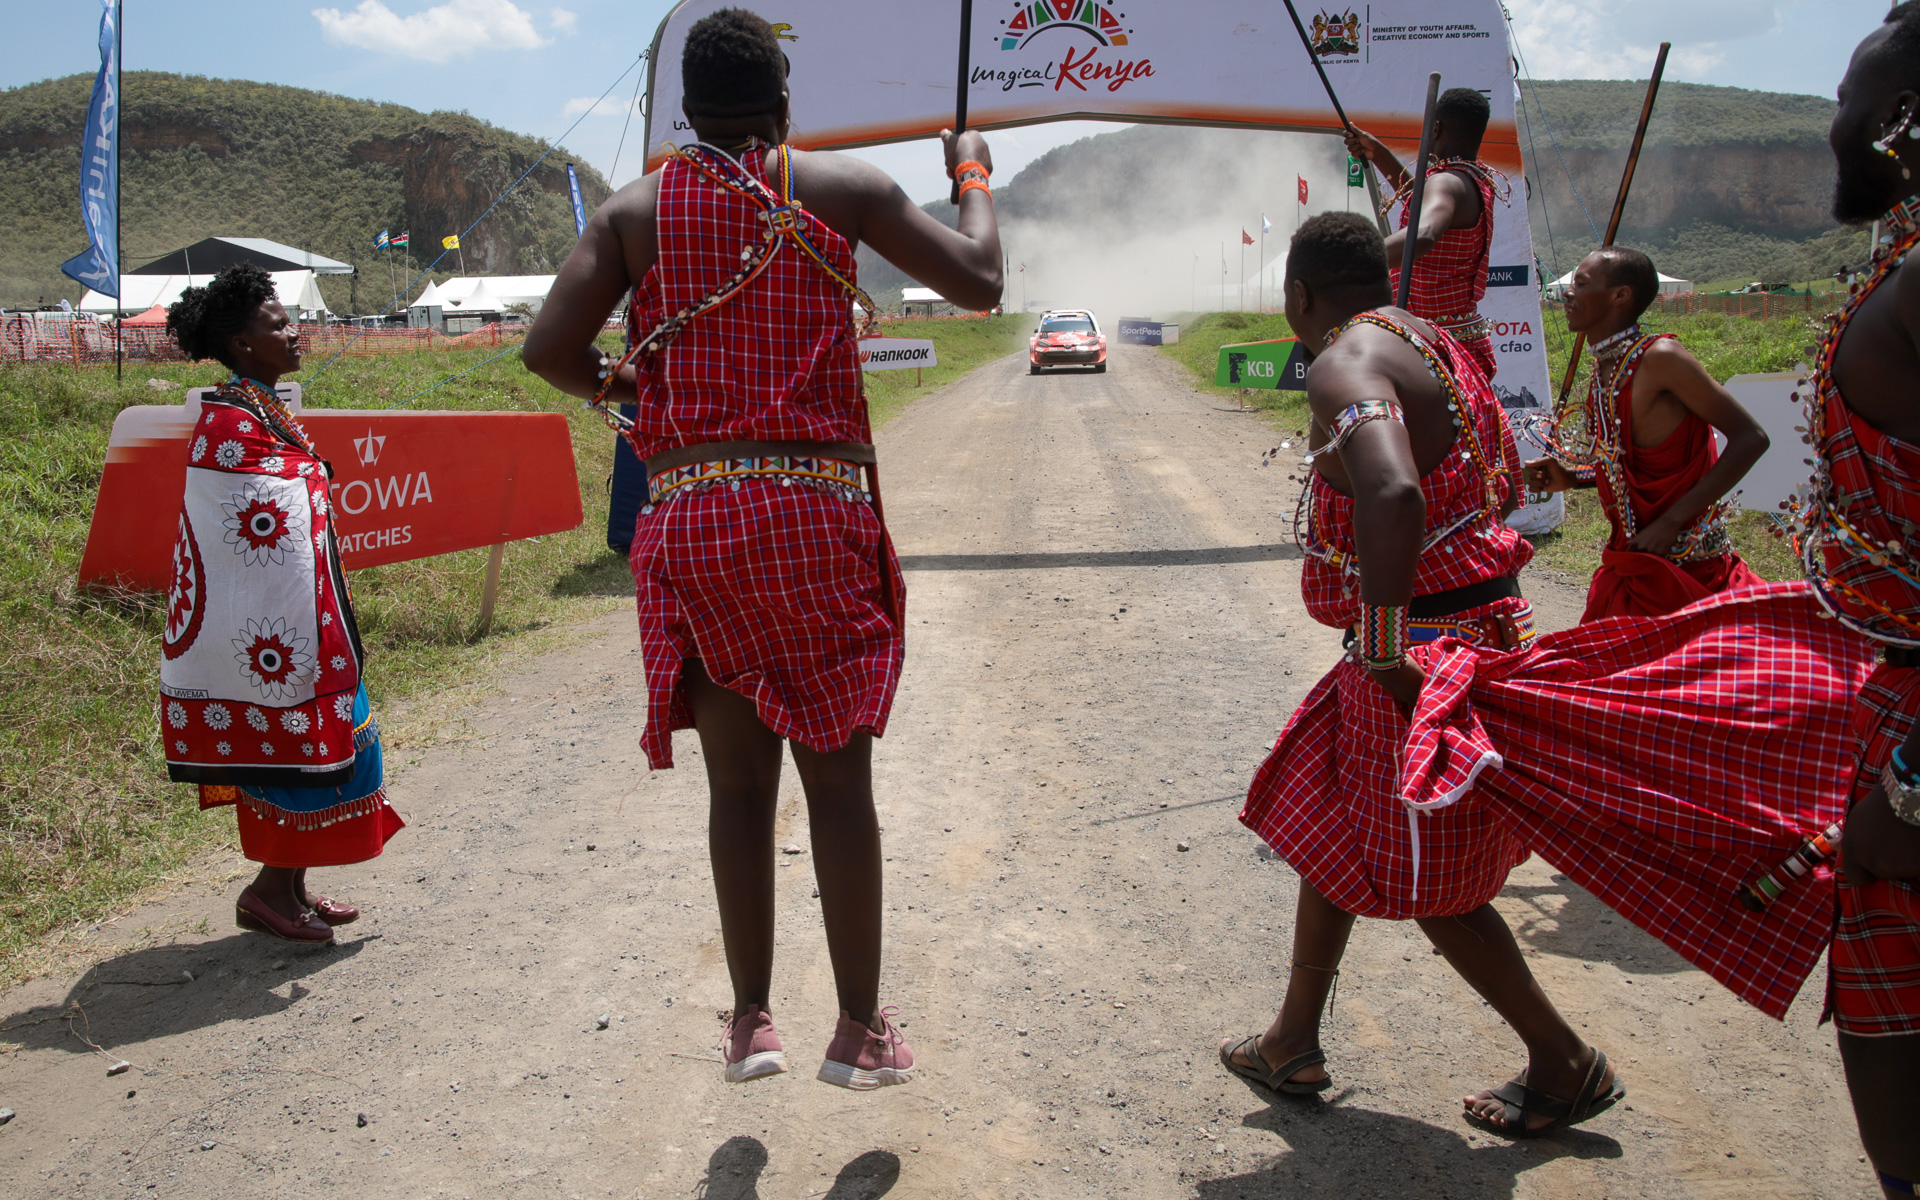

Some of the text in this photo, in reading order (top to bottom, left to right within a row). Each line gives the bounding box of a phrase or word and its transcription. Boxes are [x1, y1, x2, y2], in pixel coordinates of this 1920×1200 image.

[1054, 46, 1157, 92] Kenya
[1121, 325, 1162, 336] SportPesa
[1500, 340, 1532, 353] cfao
[1247, 360, 1275, 378] KCB
[338, 525, 412, 554] ATCHES
